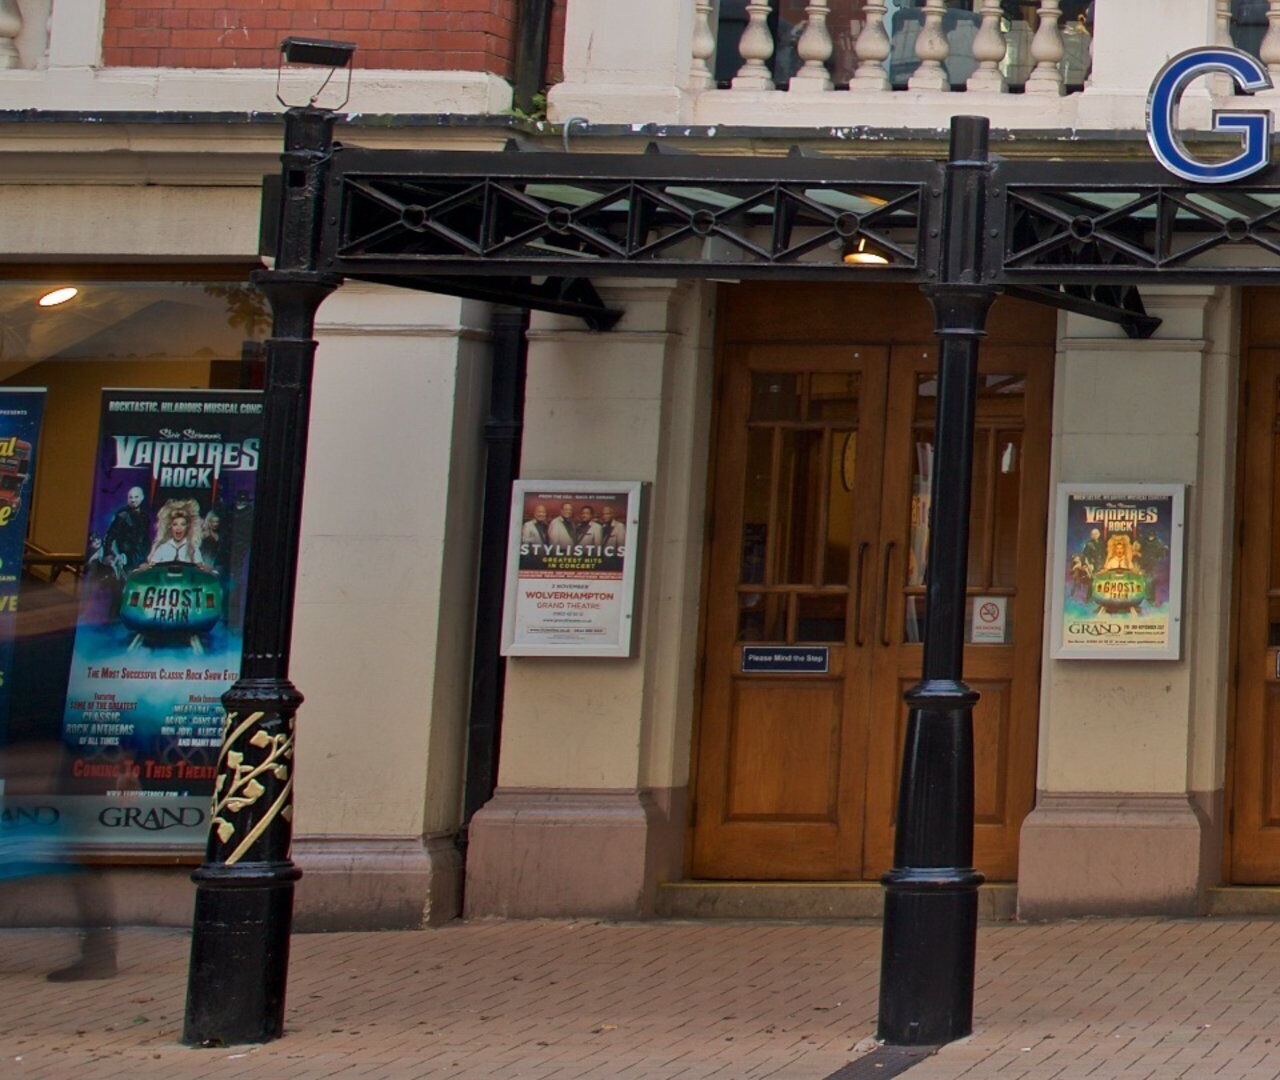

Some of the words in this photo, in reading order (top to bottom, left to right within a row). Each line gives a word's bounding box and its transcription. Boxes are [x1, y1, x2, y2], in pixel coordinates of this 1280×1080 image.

[161, 401, 202, 413] HILARIOUS
[203, 402, 239, 414] MUSICAL
[111, 434, 261, 480] VAMPIRES
[159, 467, 214, 489] ROCK
[1085, 506, 1158, 527] VAMPIRES
[1108, 521, 1133, 532] ROCK
[519, 543, 626, 558] STYLISTICS
[542, 556, 582, 564] GREATEST
[1103, 581, 1135, 593] GHOST
[143, 587, 204, 609] GHOST
[525, 591, 614, 601] WOLVERHAMPTON
[536, 602, 565, 610] GRAND
[566, 602, 601, 610] THEATRE
[153, 608, 190, 623] TRAIN
[1069, 623, 1122, 636] GRAND
[748, 654, 773, 662] Please
[774, 654, 792, 662] Mind
[793, 654, 805, 662] the
[806, 654, 823, 663] Step
[82, 711, 121, 722] CLASSIC
[66, 723, 90, 735] ROCK
[91, 724, 135, 736] ANTHEMS
[88, 737, 99, 745] ALL
[98, 806, 205, 831] GRAND
